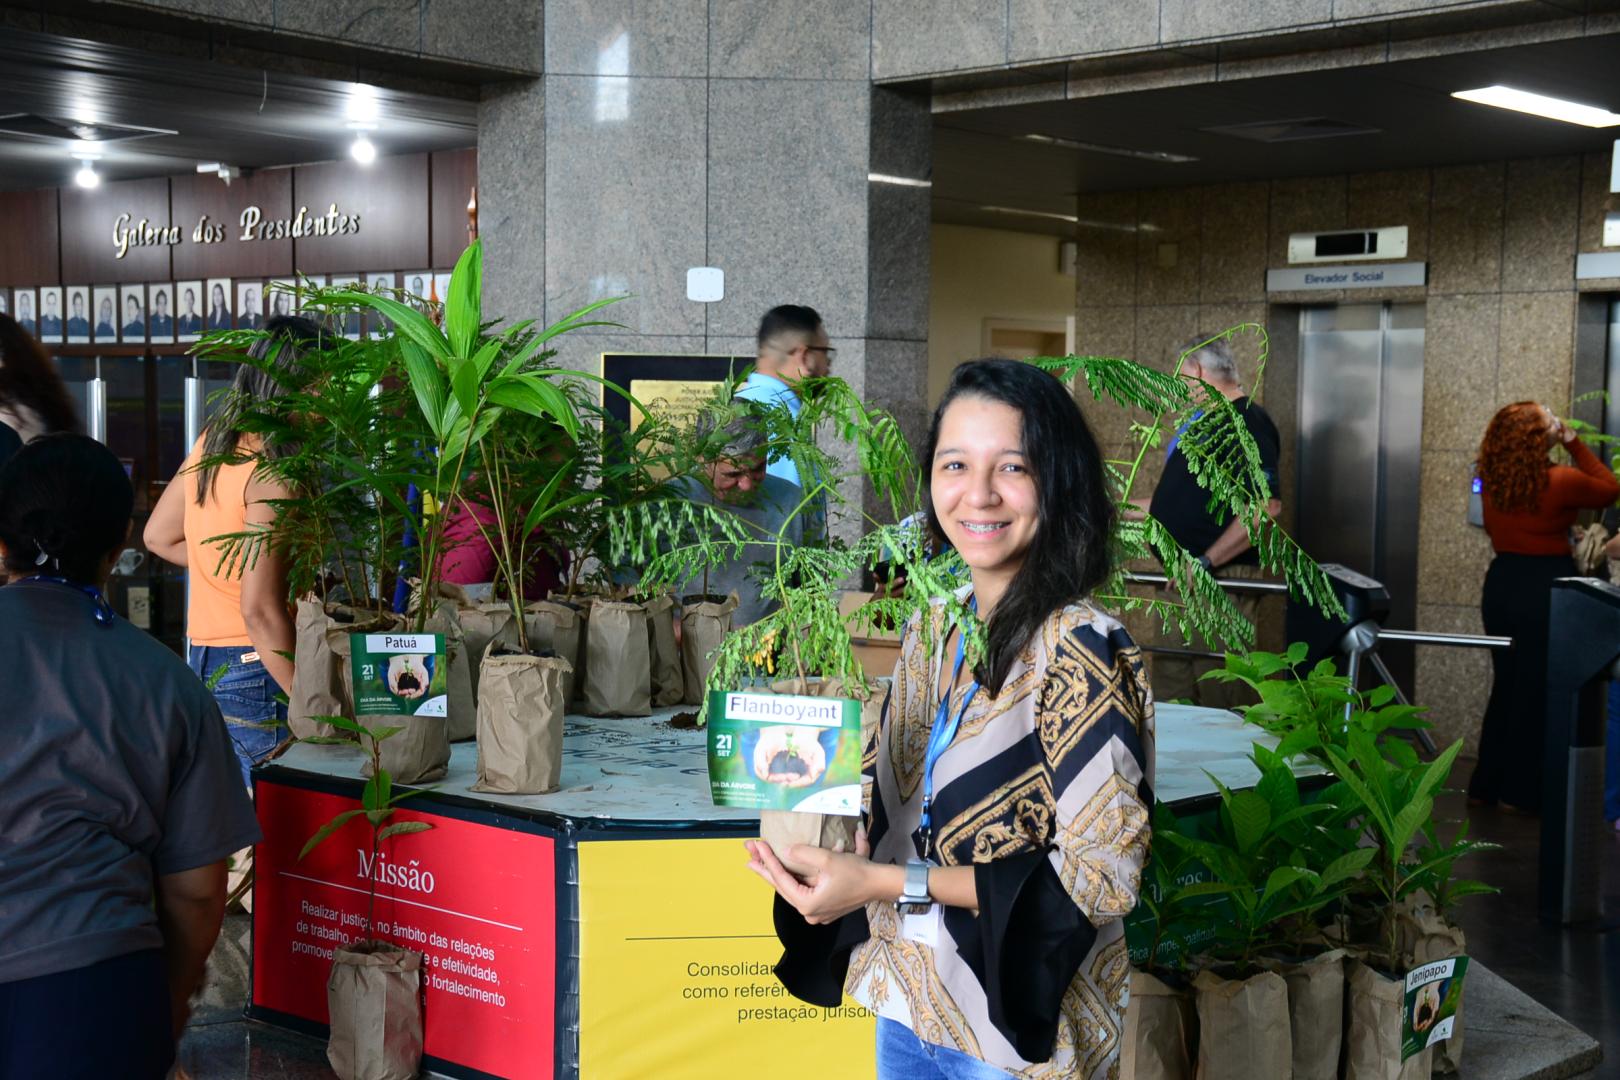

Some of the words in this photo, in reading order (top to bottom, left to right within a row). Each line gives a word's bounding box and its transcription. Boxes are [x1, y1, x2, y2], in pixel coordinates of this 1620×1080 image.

[113, 213, 182, 258] Galeria
[192, 215, 224, 243] dos
[240, 203, 360, 241] Presidentes
[1304, 273, 1347, 284] Elevador
[1352, 270, 1384, 282] Social
[385, 636, 417, 649] Patuá
[362, 664, 374, 675] 21
[730, 696, 837, 720] Flanboyant
[716, 734, 733, 749] 21
[357, 849, 435, 894] Missão
[296, 920, 309, 934] de
[311, 923, 352, 945] trabalho,
[301, 900, 339, 921] Realizar
[377, 921, 390, 934] no
[393, 922, 427, 943] âmbito
[429, 932, 448, 949] das
[451, 939, 495, 961] relações
[292, 941, 335, 961] promove
[432, 955, 439, 967] e
[442, 956, 501, 986] efetividade,
[1410, 964, 1448, 986] Jenipapo
[432, 974, 506, 1008] fortalecimento
[682, 986, 729, 999] como
[734, 982, 792, 998] referên
[738, 1004, 818, 1023] prestação
